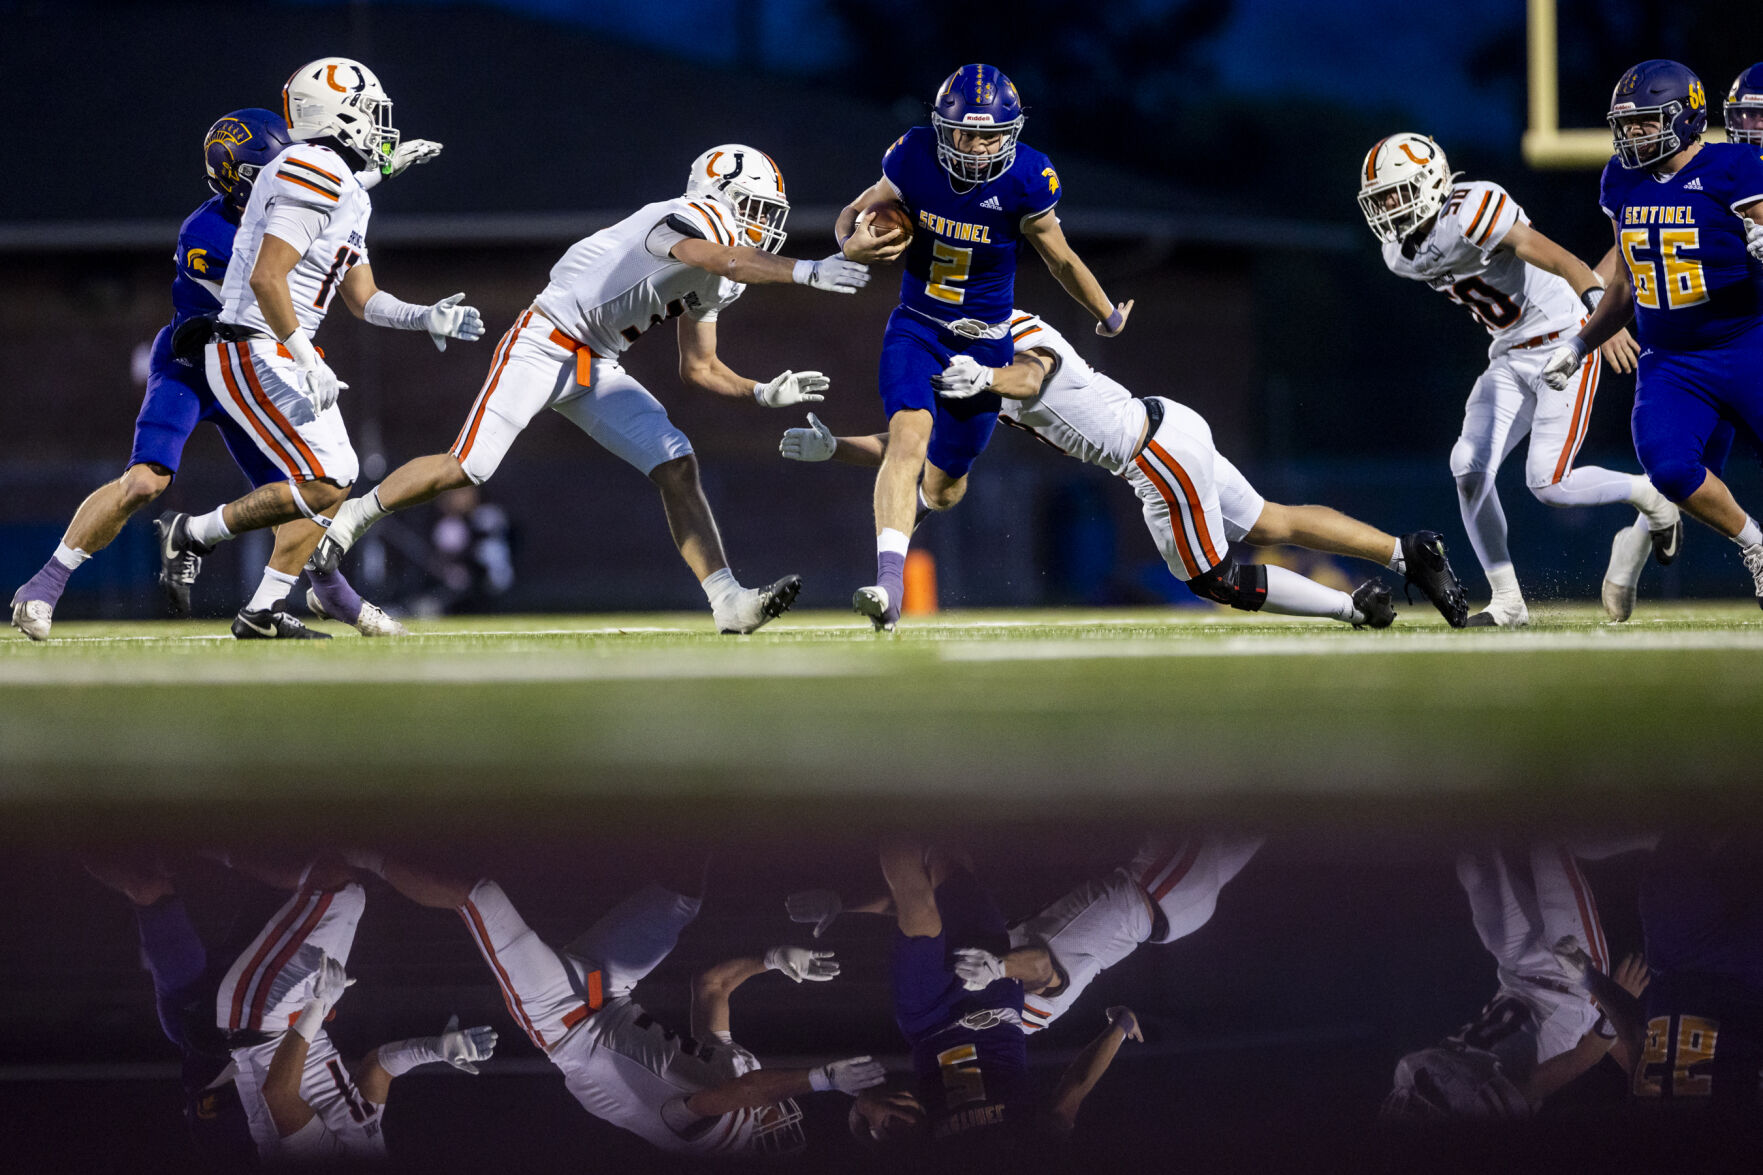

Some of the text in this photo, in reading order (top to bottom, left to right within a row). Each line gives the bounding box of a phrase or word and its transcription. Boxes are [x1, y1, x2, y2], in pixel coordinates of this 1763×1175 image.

[1688, 80, 1705, 110] 66
[979, 202, 1003, 211] adidas
[1624, 206, 1695, 224] SENTINEL
[919, 209, 991, 244] SENTINEL
[924, 239, 973, 305] 2
[1620, 228, 1711, 310] 66
